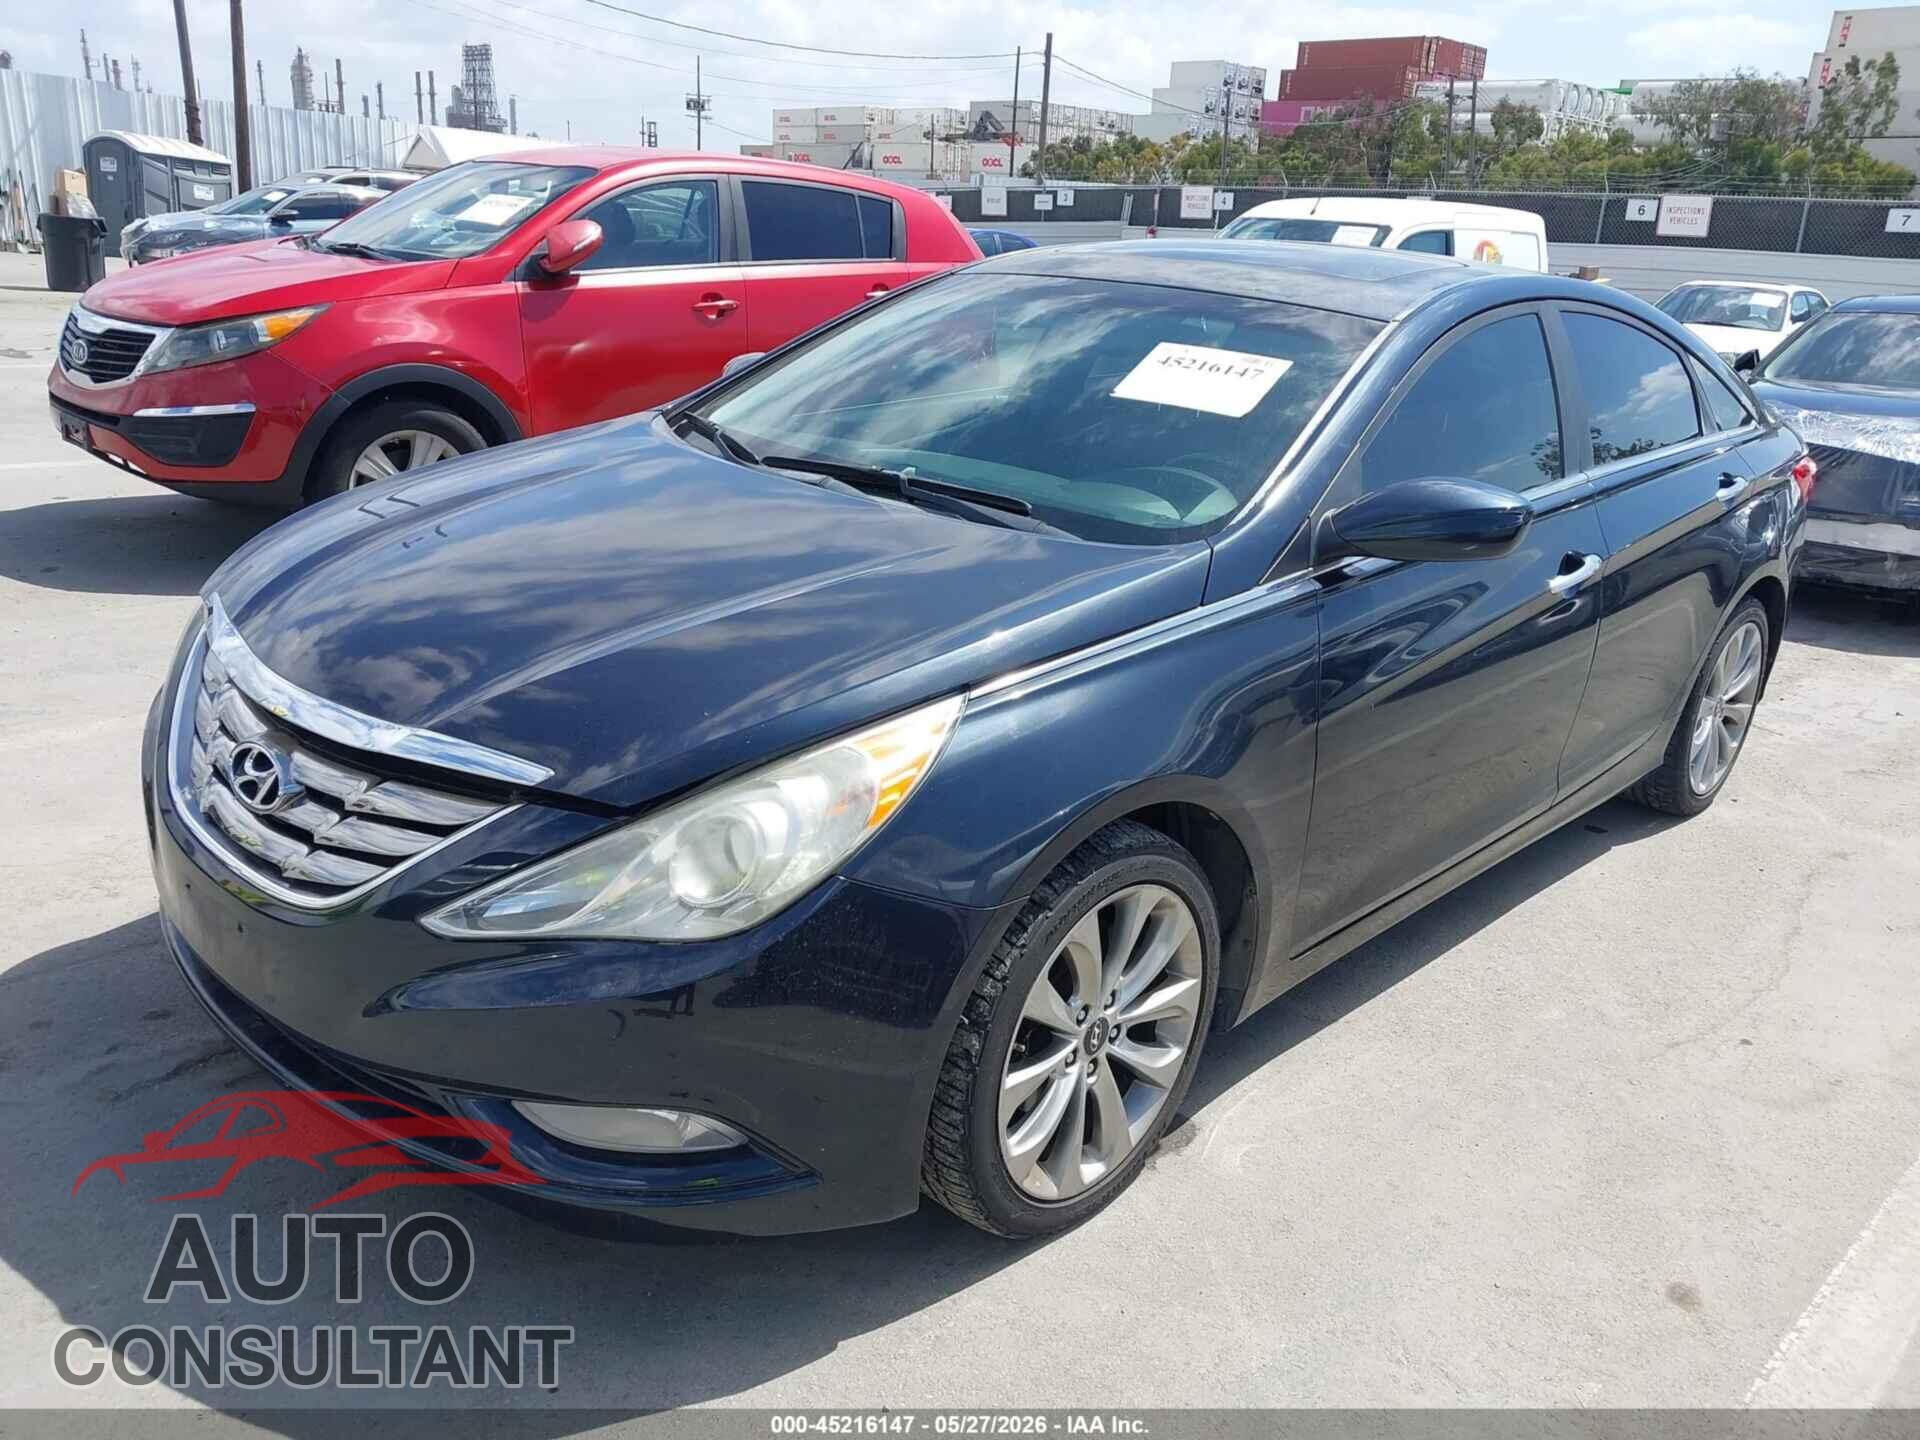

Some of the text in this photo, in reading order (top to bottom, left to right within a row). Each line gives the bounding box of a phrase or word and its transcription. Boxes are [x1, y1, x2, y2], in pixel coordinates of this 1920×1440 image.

[1221, 197, 1226, 206] 4
[1637, 204, 1646, 216] 6
[1901, 214, 1913, 226] 7
